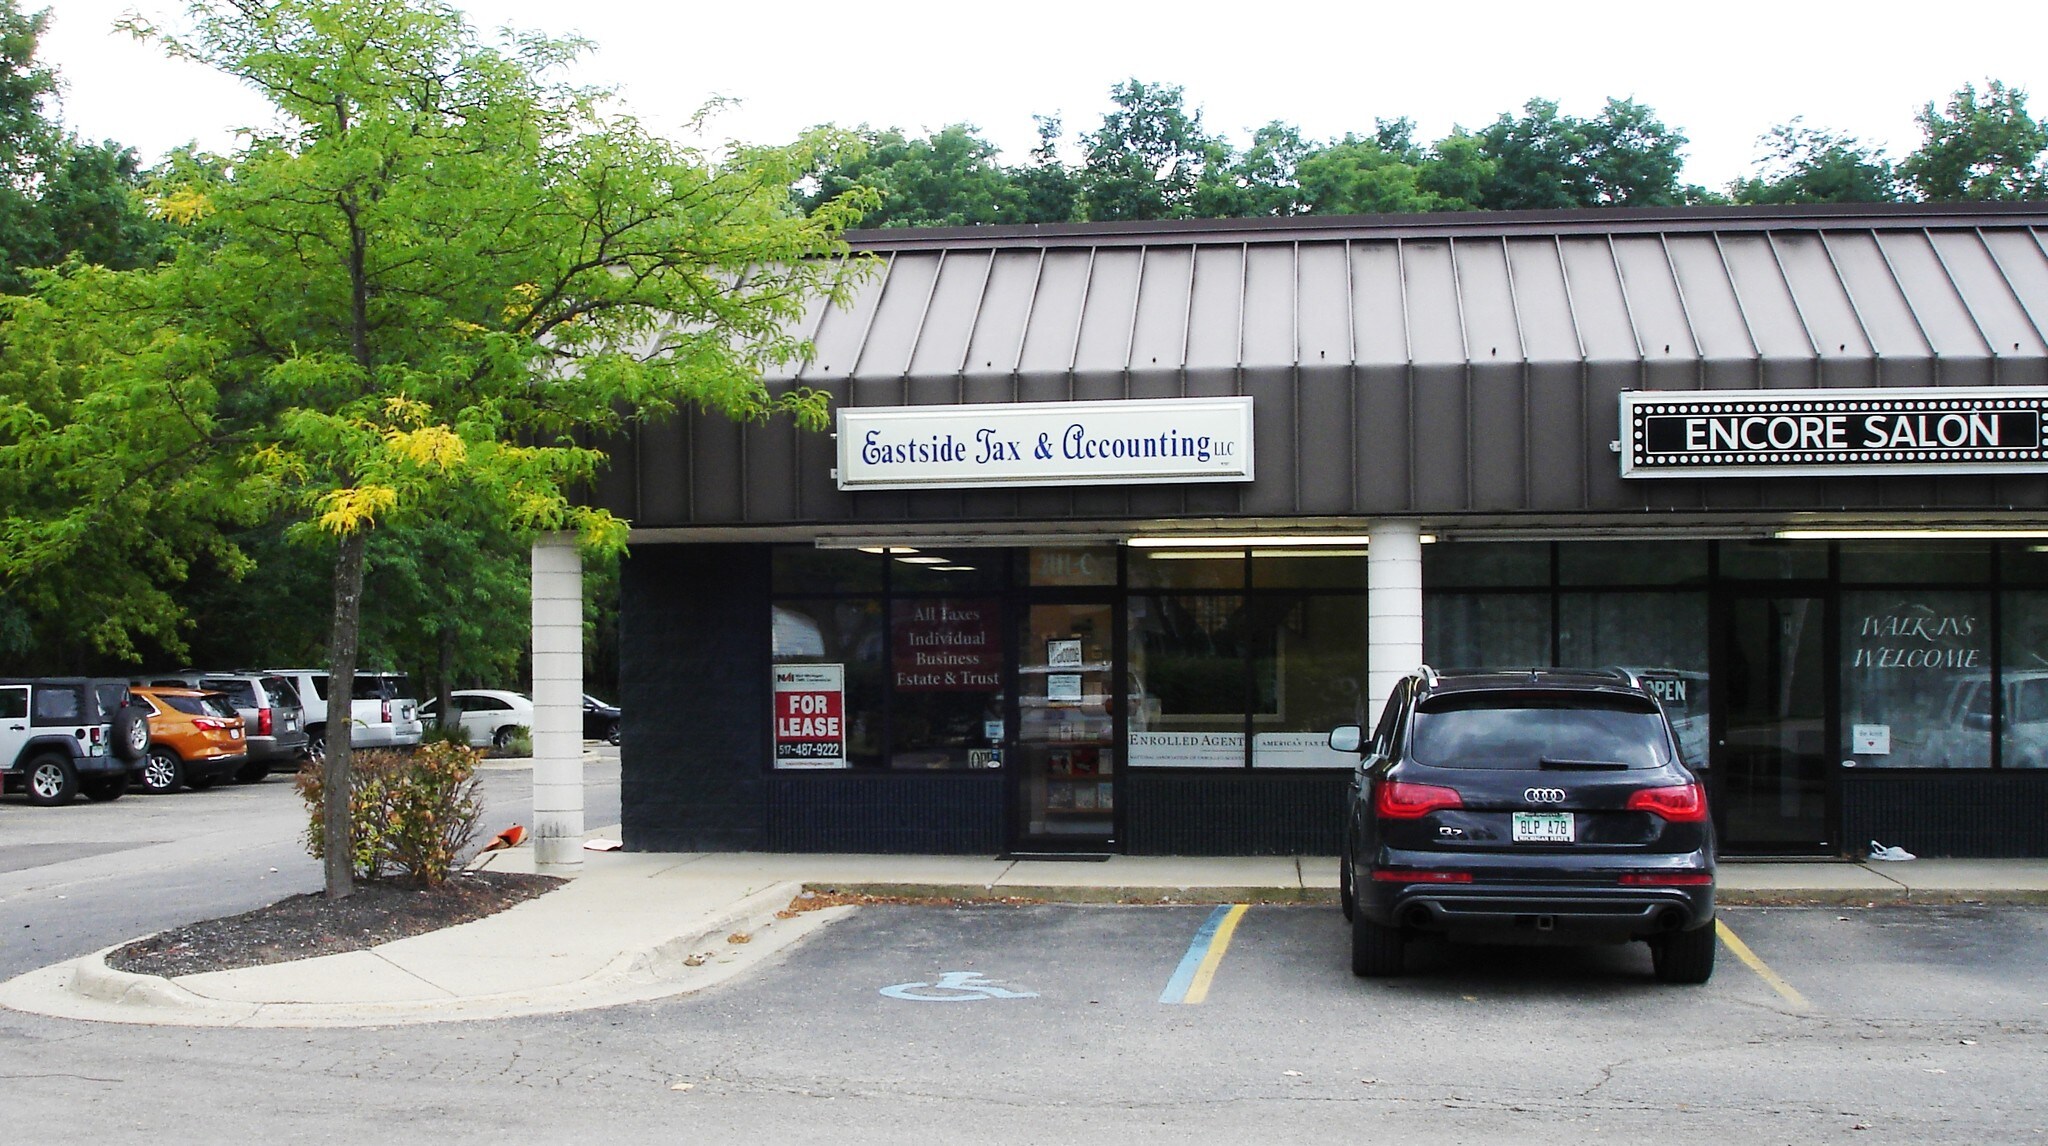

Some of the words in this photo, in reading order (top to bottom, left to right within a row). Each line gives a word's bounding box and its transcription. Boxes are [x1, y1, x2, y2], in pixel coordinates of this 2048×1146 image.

[1685, 416, 1849, 451] ENCORE
[1862, 414, 2001, 448] SALON
[862, 430, 967, 465] Eastside
[975, 428, 1021, 464] Tax
[1033, 432, 1054, 460] &
[1062, 423, 1211, 462] Accounting
[1214, 441, 1235, 456] LLC
[914, 606, 936, 621] All
[940, 607, 980, 622] Taxes
[1861, 614, 1976, 642] WALK-INS
[909, 631, 985, 646] Individual
[916, 651, 980, 666] Business
[1854, 646, 1981, 669] WELCOME
[897, 672, 941, 686] Estate
[944, 671, 957, 685] &
[960, 671, 1000, 685] Trust
[789, 695, 828, 715] FOR
[778, 717, 840, 737] LEASE
[1129, 734, 1199, 746] ENROLLED
[1201, 735, 1245, 747] AGENT
[779, 743, 839, 756] 517-487-9222
[1439, 826, 1463, 836] Q7
[1520, 820, 1540, 835] 8LP
